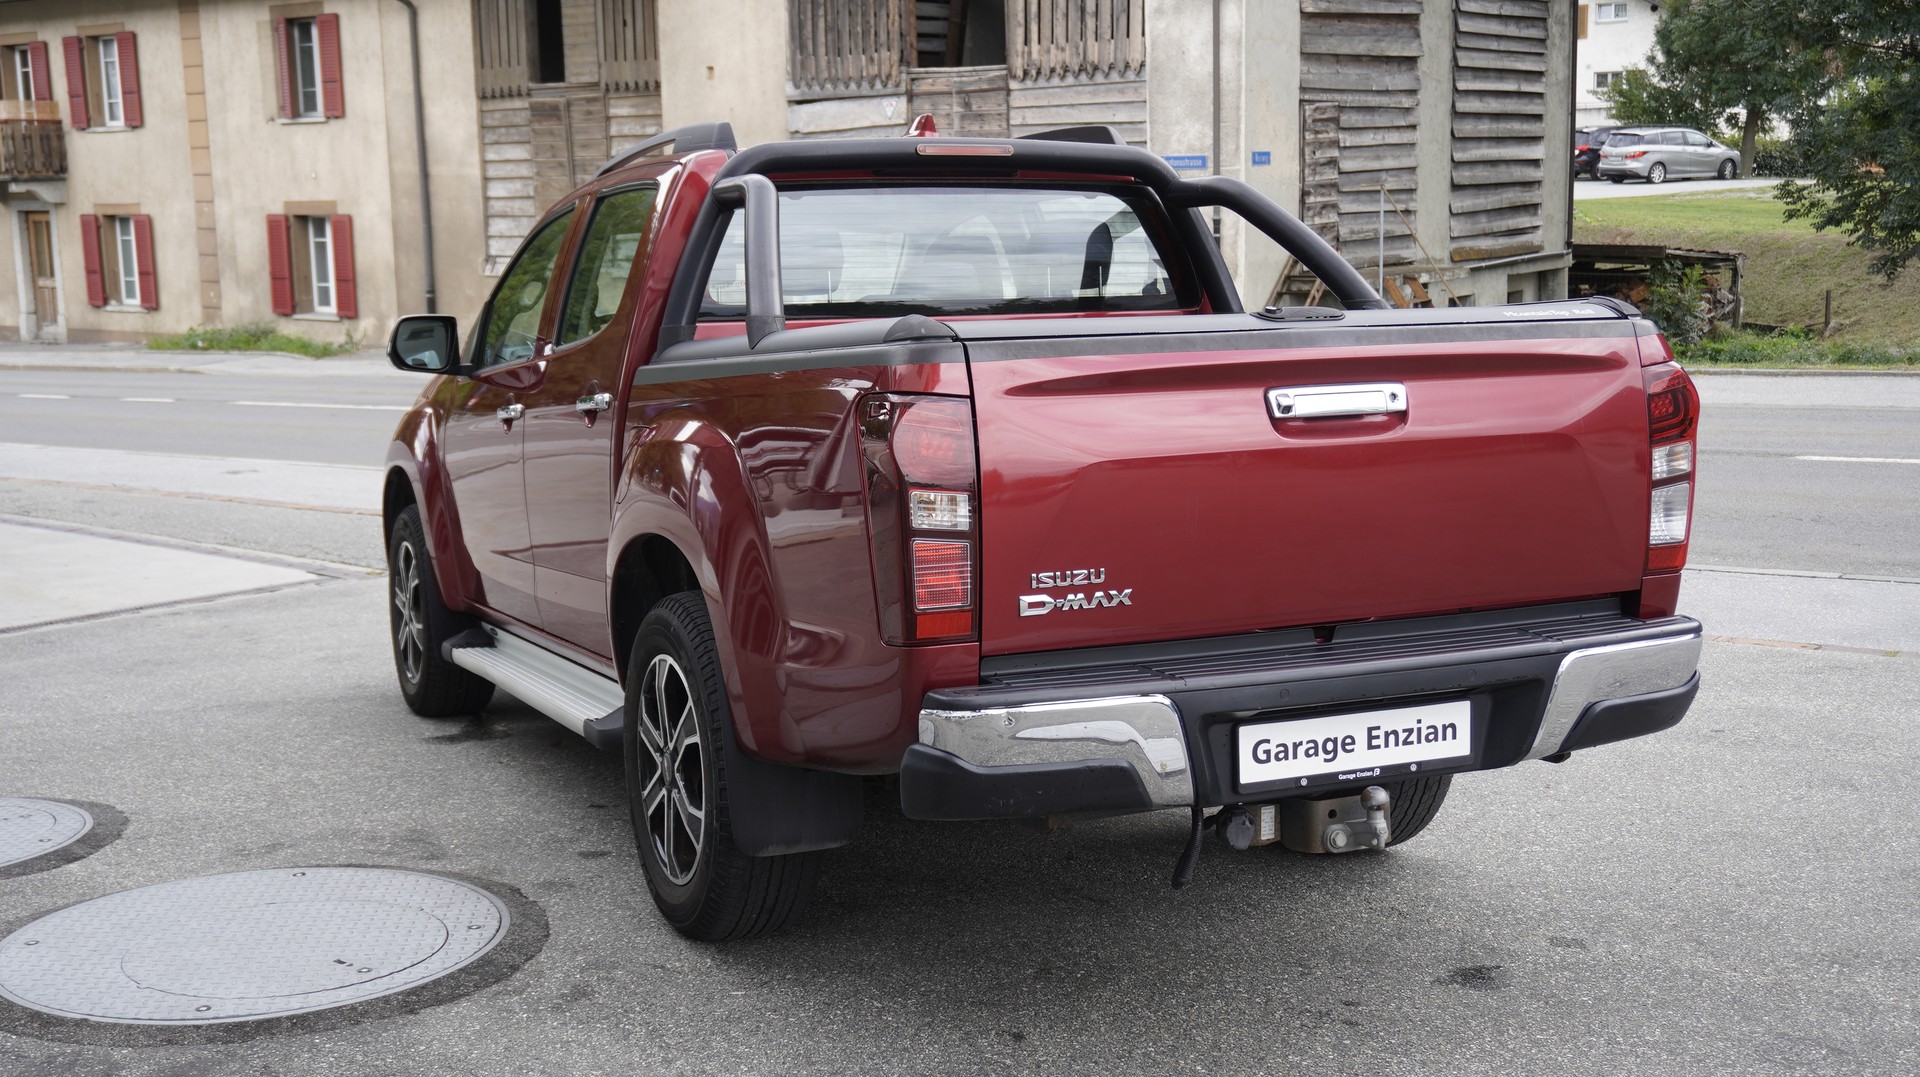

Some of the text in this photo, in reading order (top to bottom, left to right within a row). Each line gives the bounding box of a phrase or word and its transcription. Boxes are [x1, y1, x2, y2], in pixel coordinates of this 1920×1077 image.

[1031, 568, 1105, 588] ISUZU
[1019, 588, 1133, 617] D-MAX
[1252, 719, 1457, 764] Garage Enzian
[1356, 770, 1373, 778] Enzian
